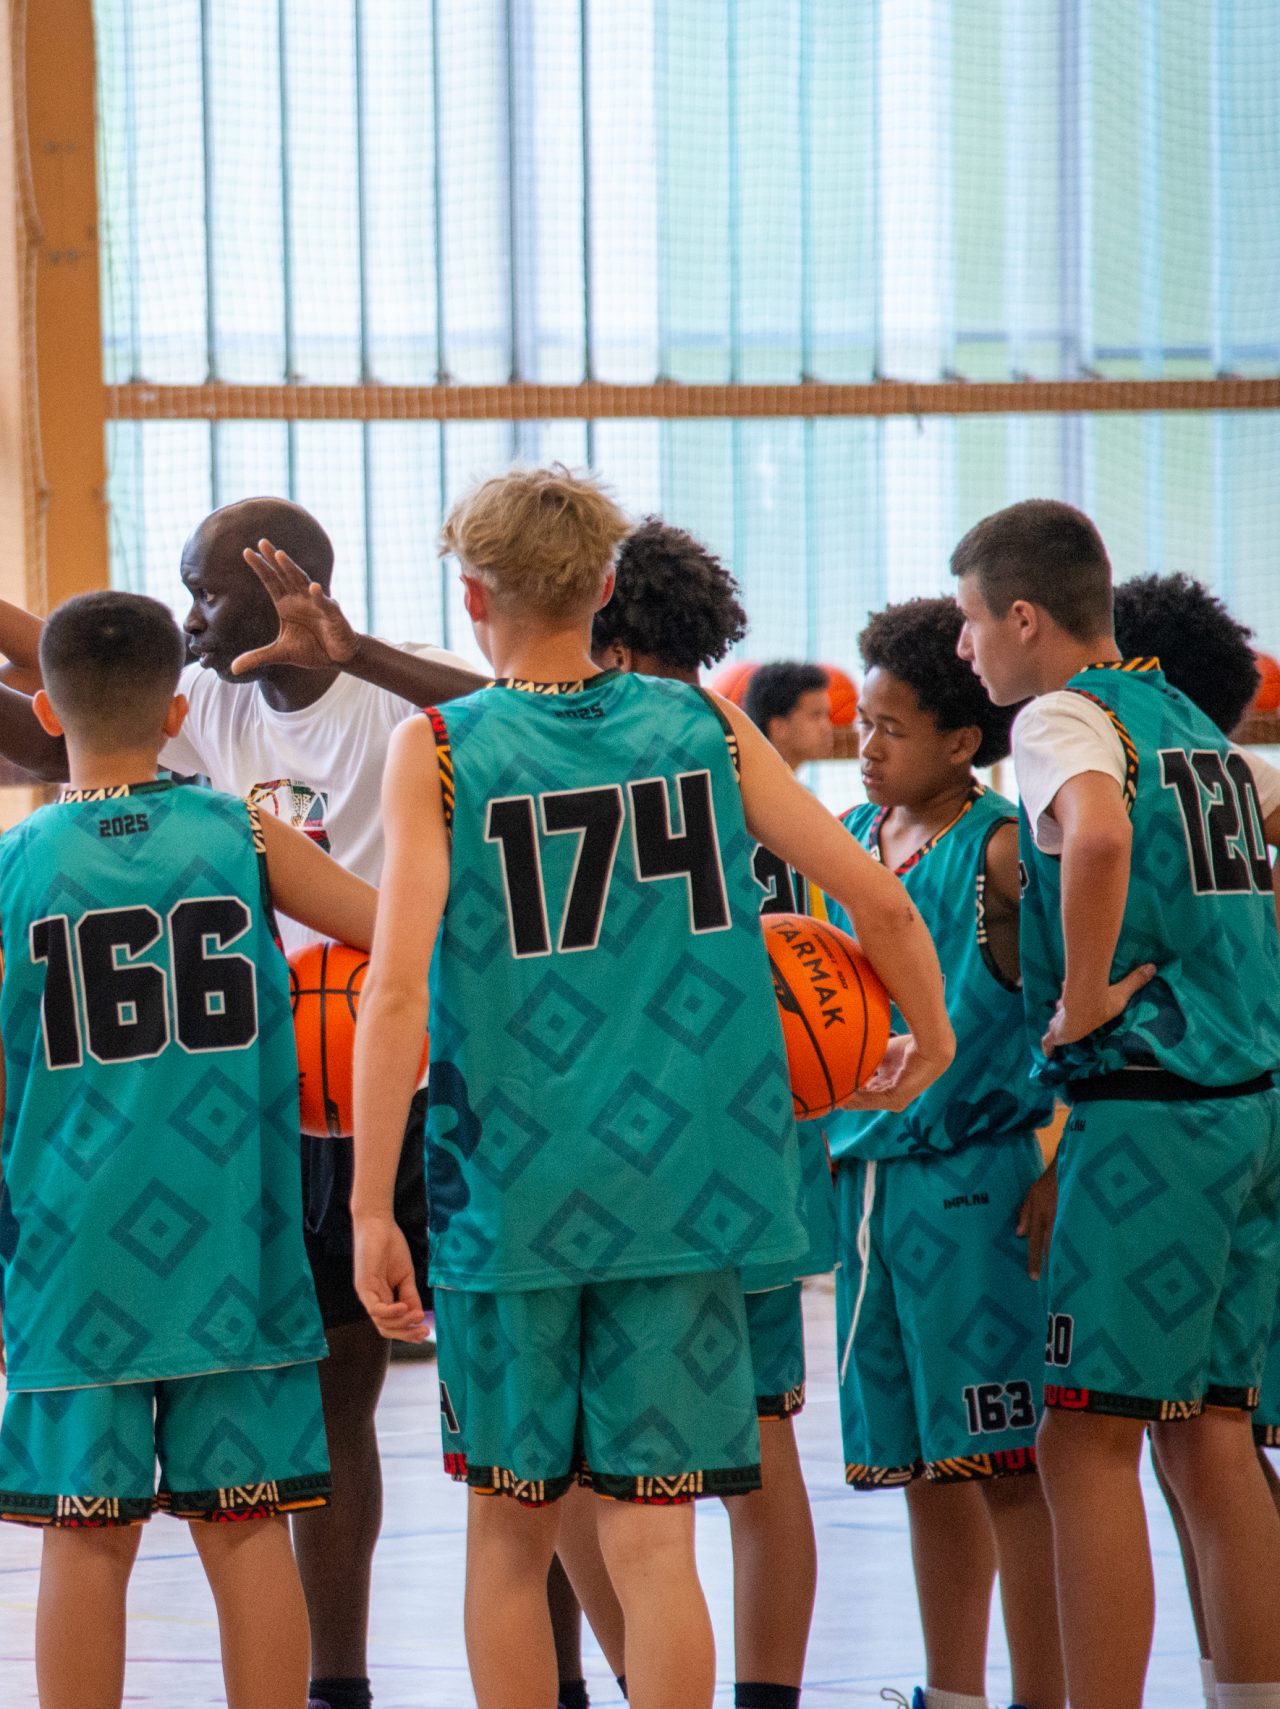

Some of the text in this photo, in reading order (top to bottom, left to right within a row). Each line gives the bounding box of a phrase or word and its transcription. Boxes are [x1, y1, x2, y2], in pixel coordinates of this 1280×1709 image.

[99, 813, 149, 837] 2025
[484, 769, 731, 959] 174
[1157, 748, 1274, 895] 120
[29, 895, 259, 1070] 166
[770, 920, 845, 1029] TARMAK
[963, 1380, 1036, 1436] 163
